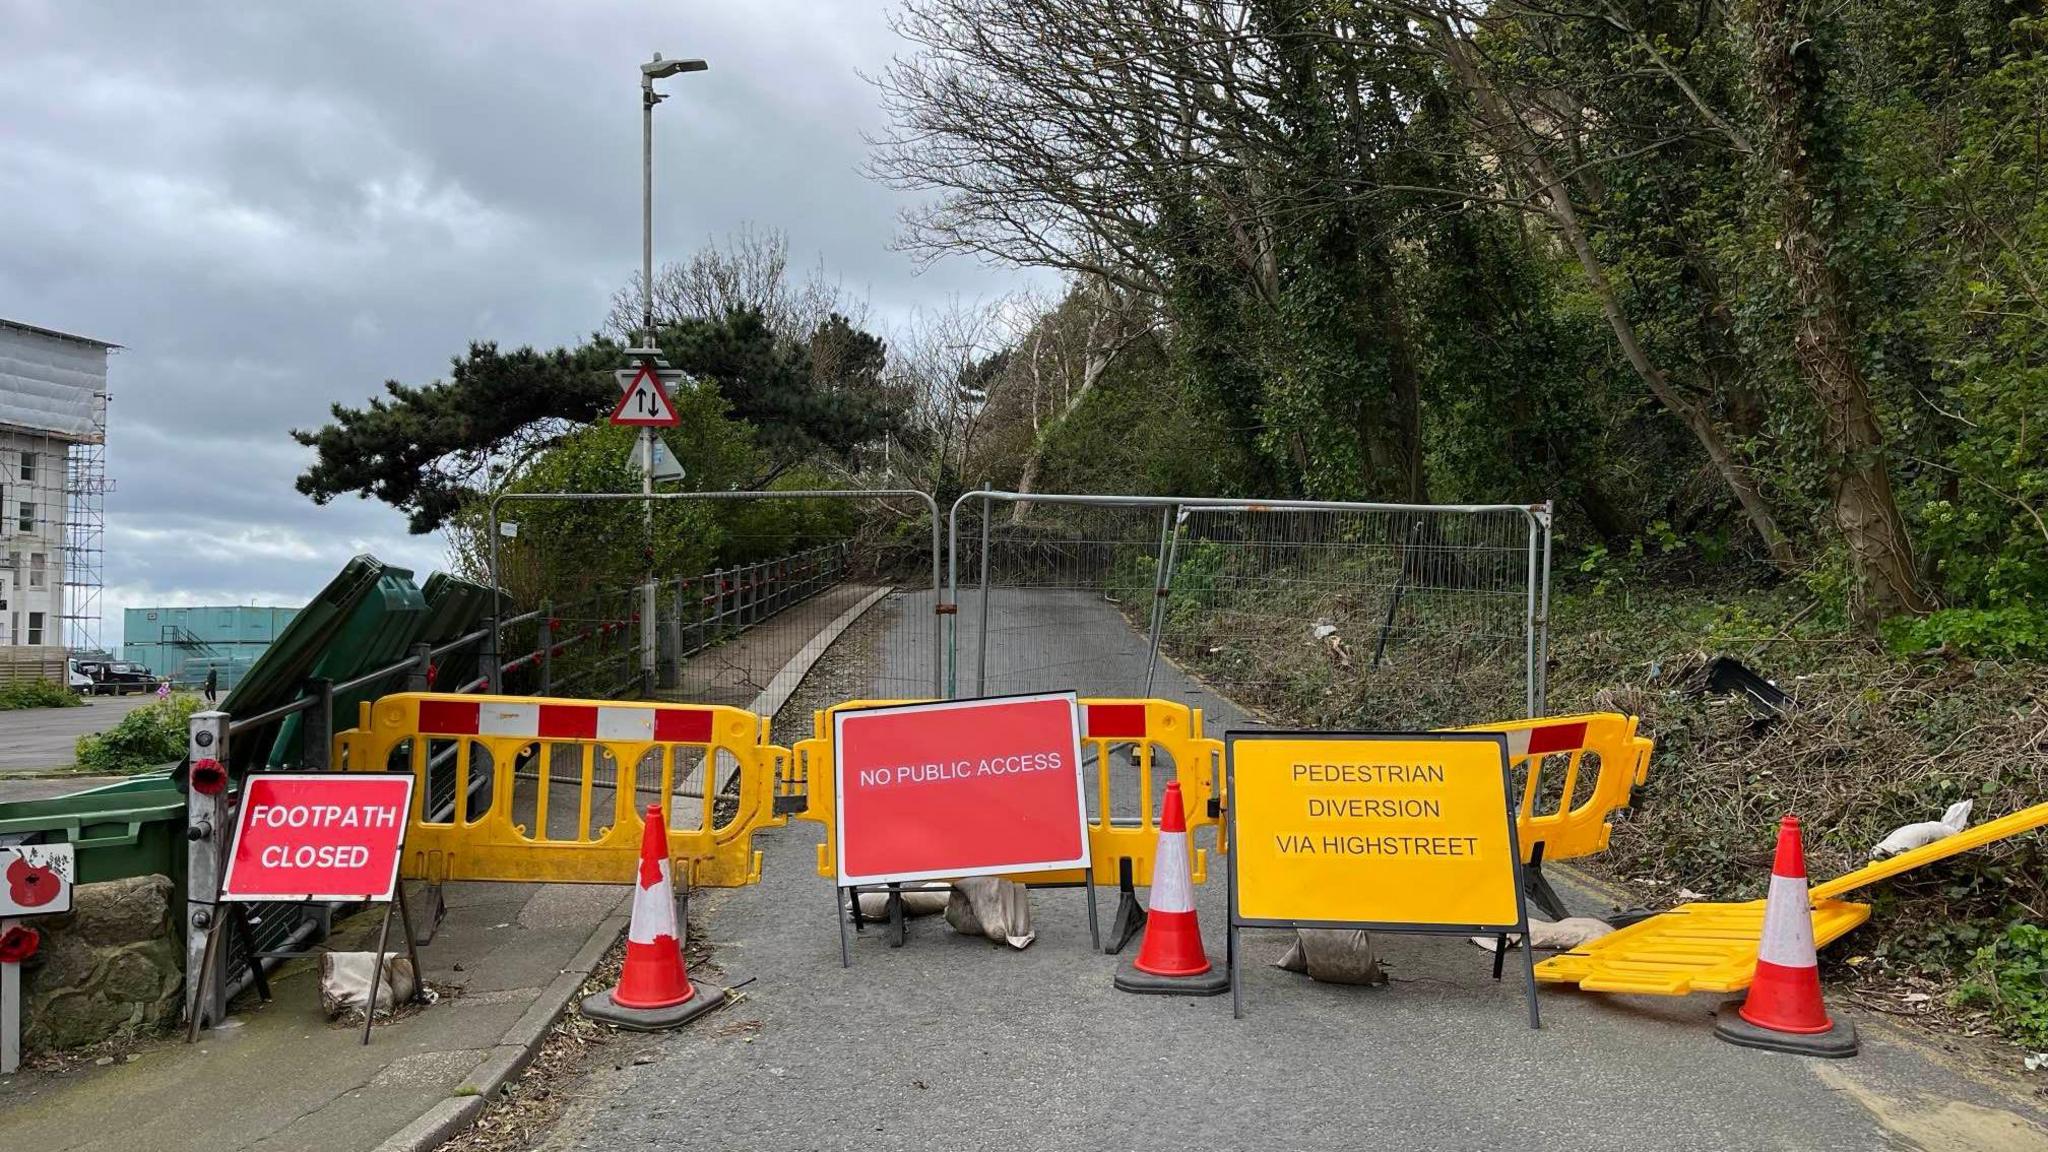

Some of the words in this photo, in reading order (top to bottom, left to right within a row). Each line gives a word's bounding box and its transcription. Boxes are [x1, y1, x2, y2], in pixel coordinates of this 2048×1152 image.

[860, 767, 890, 787] NO
[897, 761, 972, 784] PUBLIC
[977, 752, 1062, 776] ACCESS
[1293, 763, 1444, 782] PEDESTRIAN
[250, 806, 397, 828] FOOTPATH
[1309, 799, 1440, 817] DIVERSION
[1276, 835, 1315, 854] VIA
[1323, 836, 1478, 856] HIGHSTREET
[261, 845, 370, 868] CLOSED
